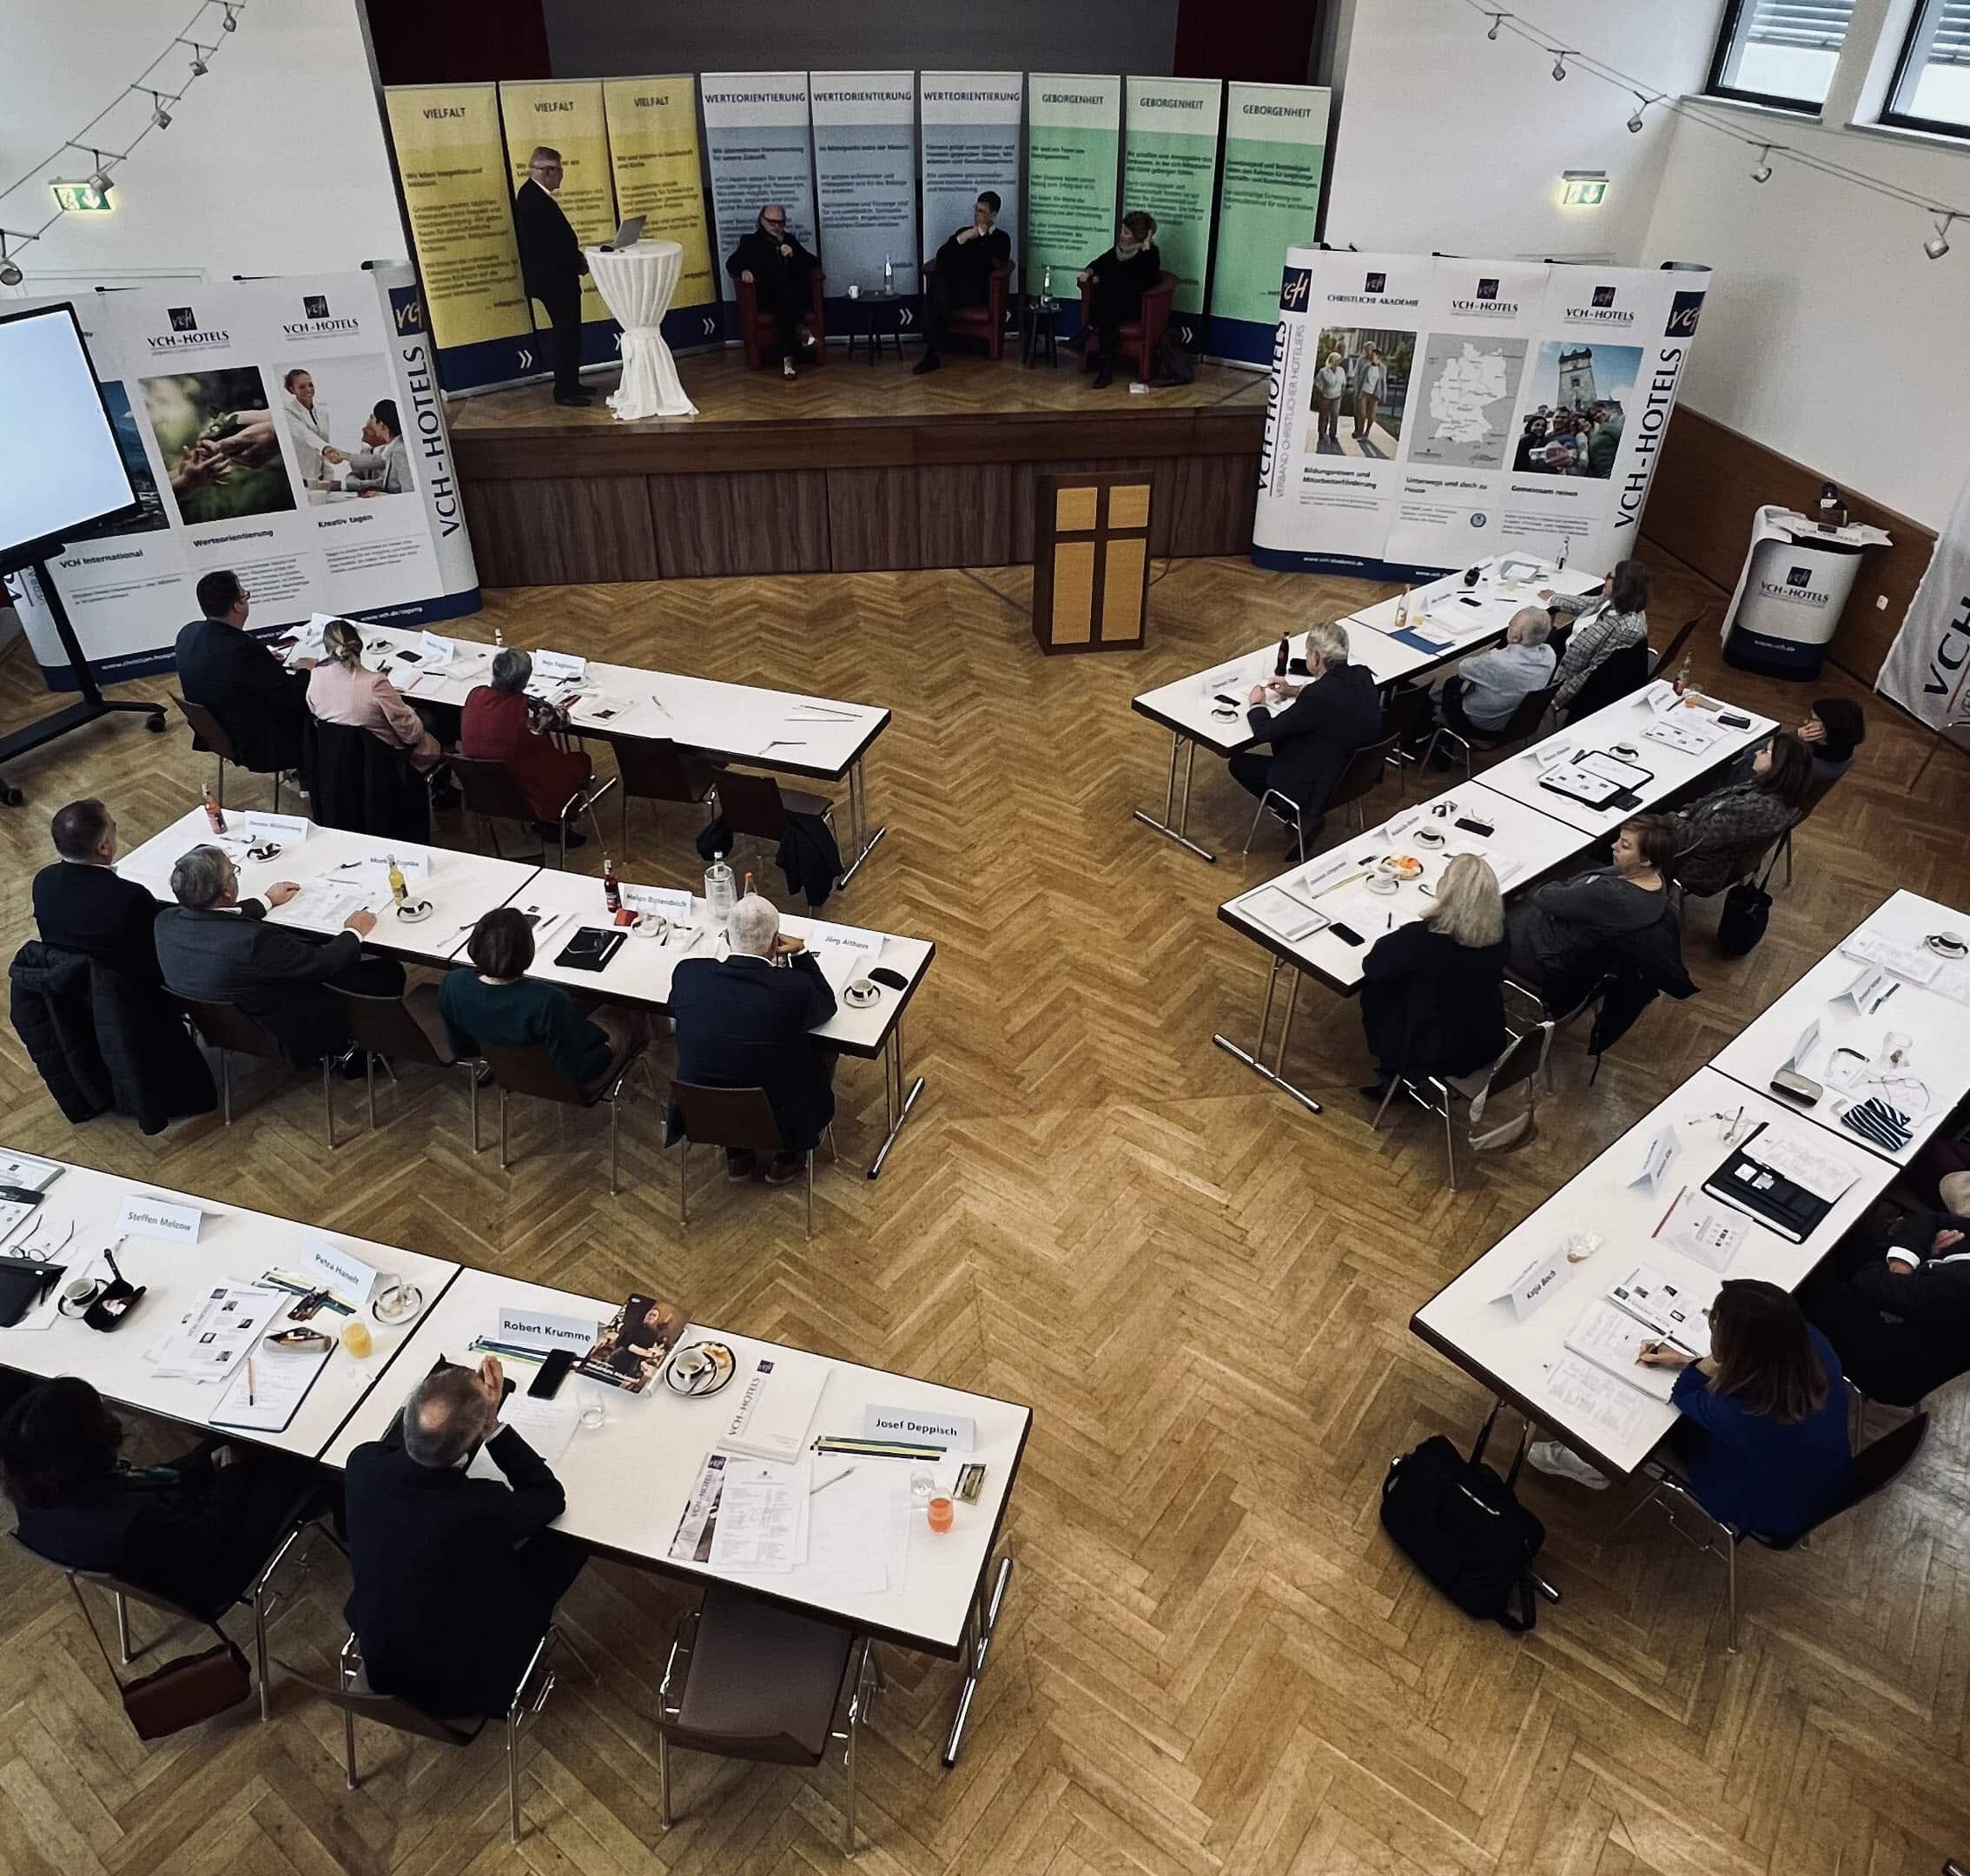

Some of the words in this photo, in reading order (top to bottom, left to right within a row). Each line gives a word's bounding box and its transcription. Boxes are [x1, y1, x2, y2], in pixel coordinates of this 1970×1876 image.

[634, 96, 669, 108] VIELFALT
[704, 92, 806, 104] WERTEORIENTIERUNG
[813, 91, 912, 102] WERTEORIENTIERUNG
[923, 91, 1021, 102] WERTEORIENTIERUNG
[1041, 94, 1104, 105] GEBORGENHEIT
[534, 102, 574, 113] VIELFALT
[1140, 97, 1204, 110] GEBORGENHEIT
[423, 107, 466, 120] VIELFALT
[1242, 104, 1312, 118] GEBORGENHEIT
[1327, 294, 1377, 304] CHRISTLICHE
[1379, 297, 1419, 307] AKADEMIE
[1281, 380, 1299, 451] CHRISTLICHER
[1291, 324, 1306, 380] HOTELIERS
[1511, 485, 1554, 495] Gemeinsam
[318, 519, 347, 529] Kreativ
[349, 514, 374, 524] tagen
[193, 530, 274, 547] Werteorientierung
[59, 558, 81, 569] VCH
[83, 549, 144, 565] International
[128, 1211, 158, 1225] Steffen
[314, 1253, 334, 1271] Petra
[503, 1320, 542, 1335] Robert
[545, 1326, 592, 1343] Krumme
[876, 1417, 905, 1430] Josef
[907, 1421, 957, 1437] Deppisch
